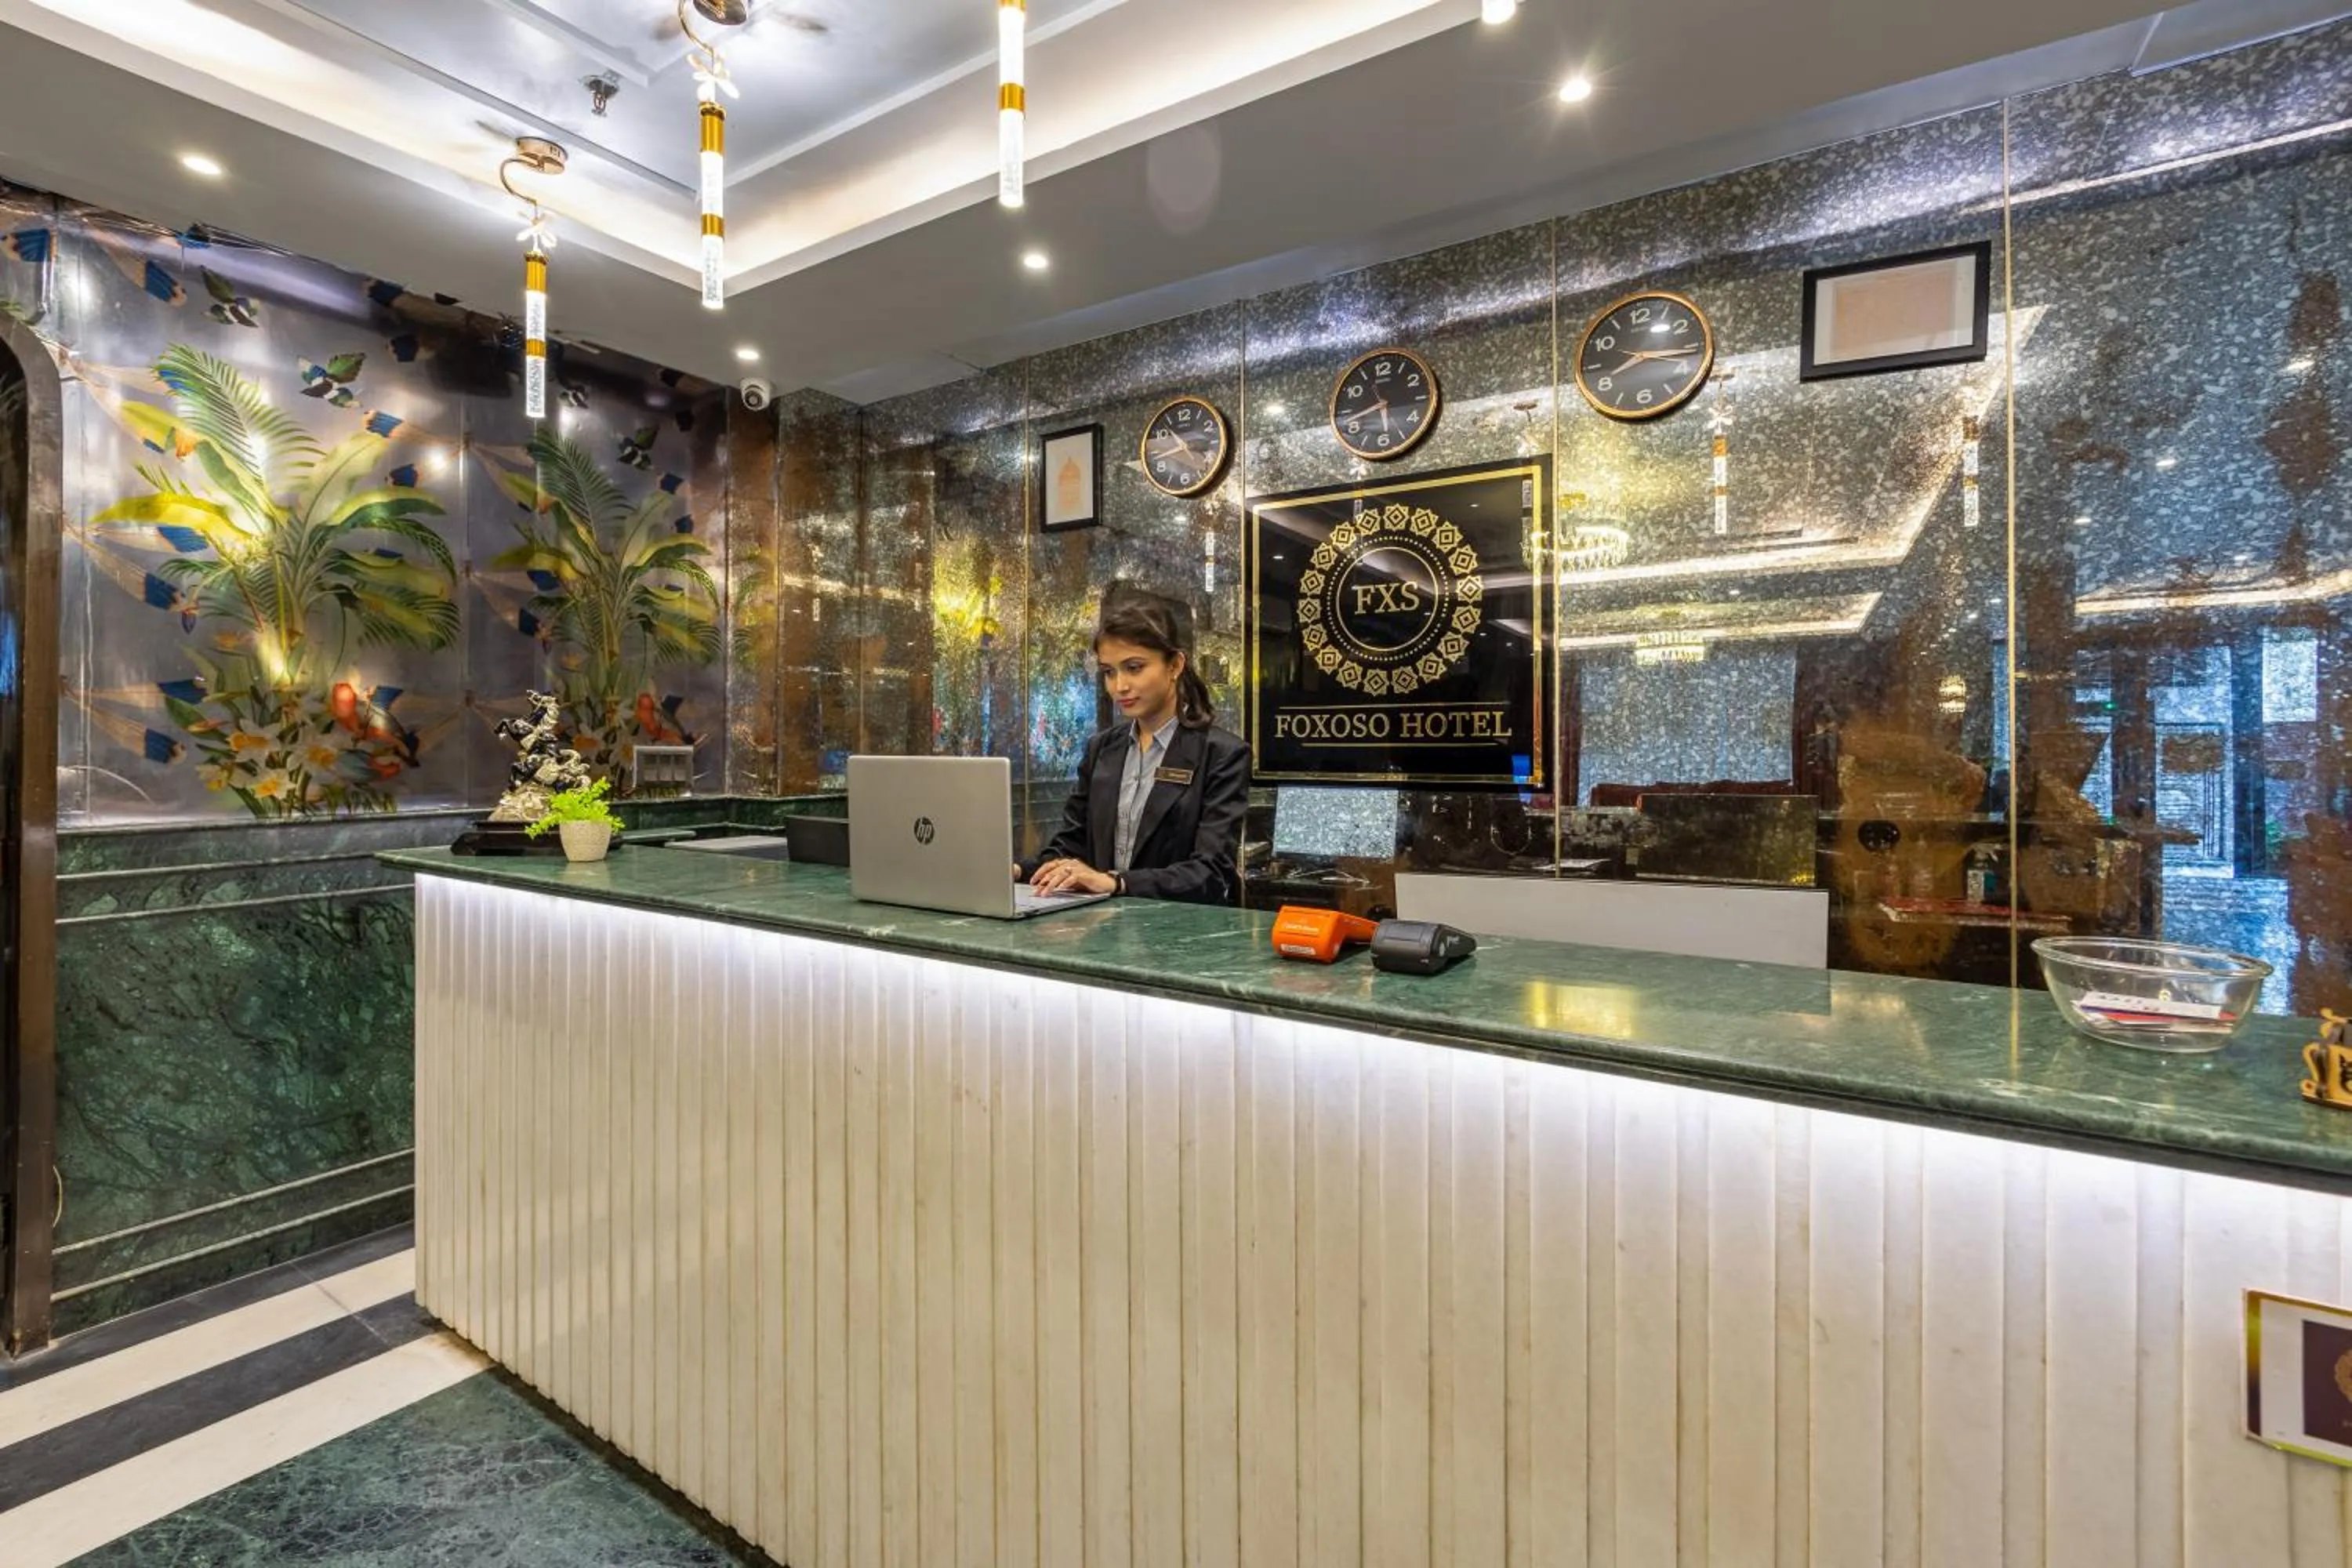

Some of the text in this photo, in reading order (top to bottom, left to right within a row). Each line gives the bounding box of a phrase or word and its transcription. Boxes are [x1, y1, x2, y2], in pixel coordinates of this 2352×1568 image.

[1630, 308, 1651, 325] 12
[1673, 319, 1690, 335] 2
[1595, 335, 1616, 352] 10
[1374, 361, 1392, 376] 12
[1407, 373, 1420, 387] 2
[1598, 377, 1613, 391] 8
[1346, 384, 1363, 399] 10
[1636, 389, 1653, 404] 6
[1177, 408, 1191, 421] 12
[1406, 408, 1420, 423] 4
[1203, 419, 1214, 433] 2
[1348, 421, 1360, 434] 8
[1156, 429, 1168, 440] 10
[1377, 434, 1390, 446] 6
[1156, 461, 1167, 473] 8
[1180, 472, 1190, 485] 6
[1354, 581, 1420, 615] FXS
[1274, 710, 1512, 739] FOXOSO HOTEL
[916, 816, 933, 845] hp
